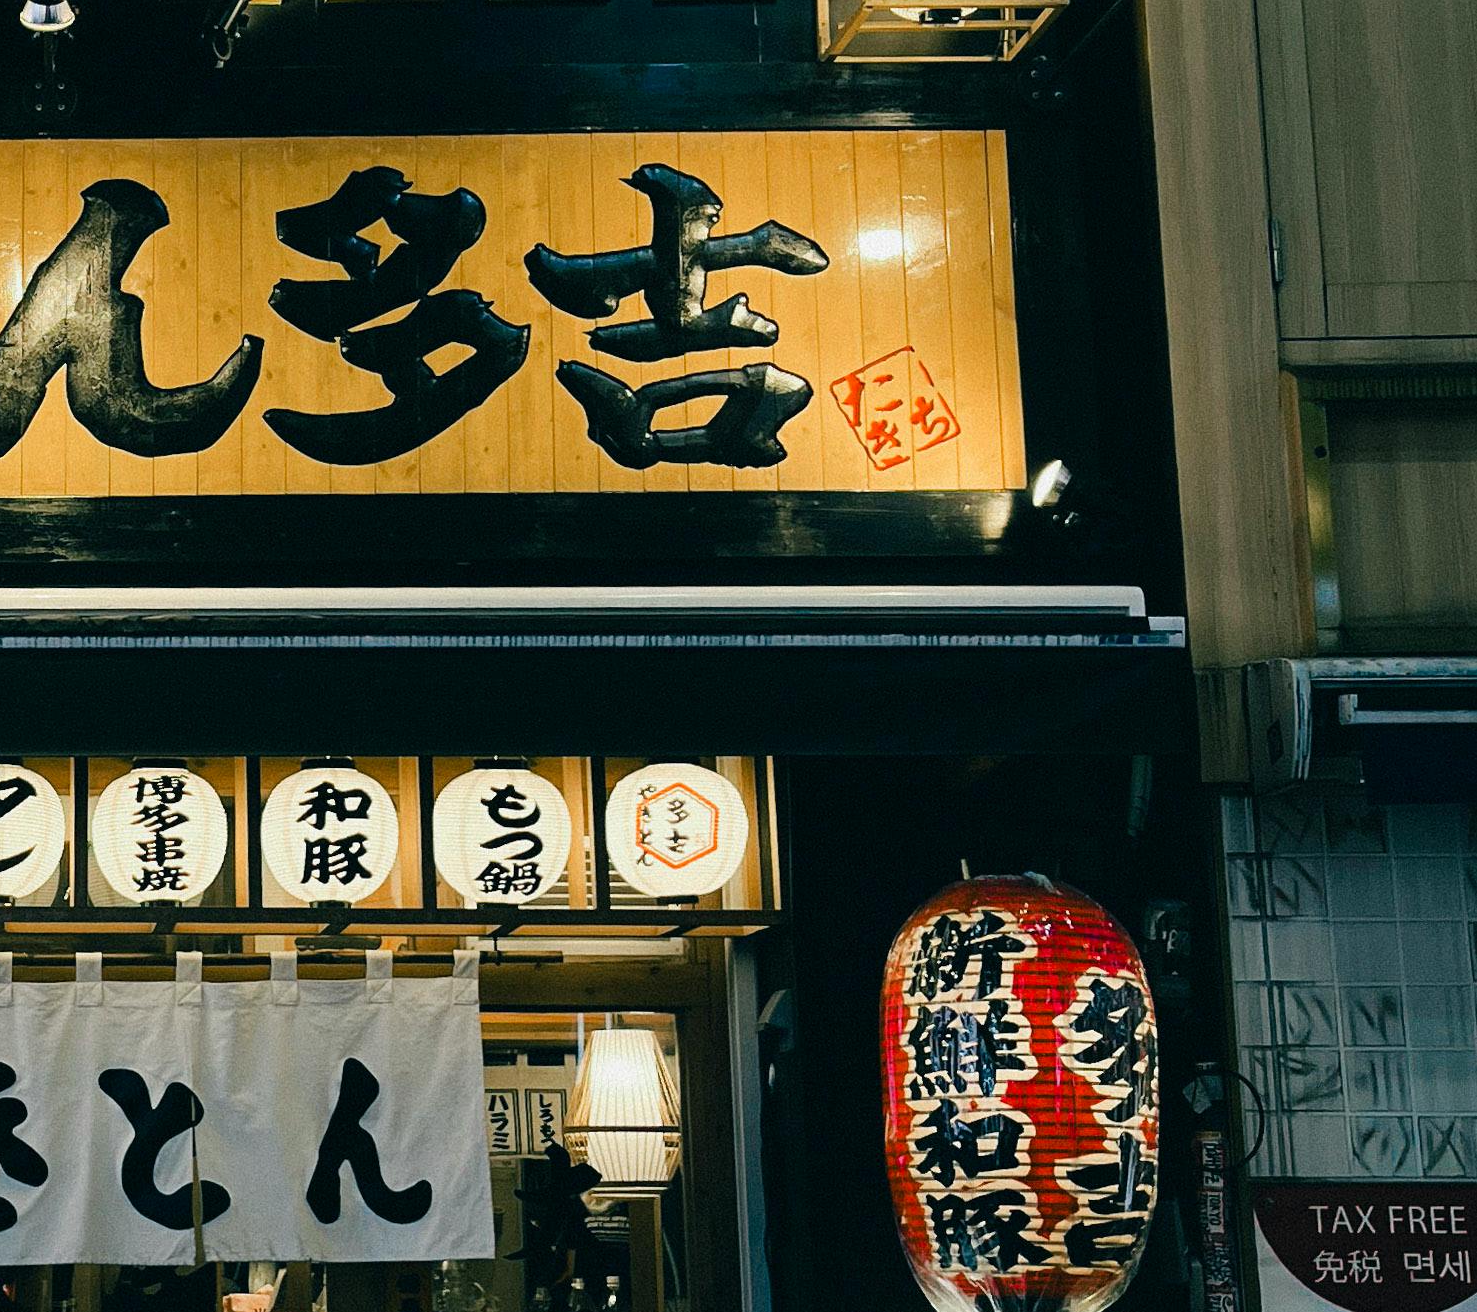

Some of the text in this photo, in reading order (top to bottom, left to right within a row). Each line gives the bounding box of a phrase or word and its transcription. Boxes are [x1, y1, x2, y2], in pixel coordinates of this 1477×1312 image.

[128, 774, 190, 893] 博多串焼
[296, 780, 373, 887] 和豚
[475, 783, 544, 897] もつ鍋
[487, 1094, 511, 1150] ハラミ
[1309, 1205, 1468, 1234] TAX FREE
[1313, 1249, 1383, 1284] 免税
[1403, 1249, 1471, 1284] 면세
